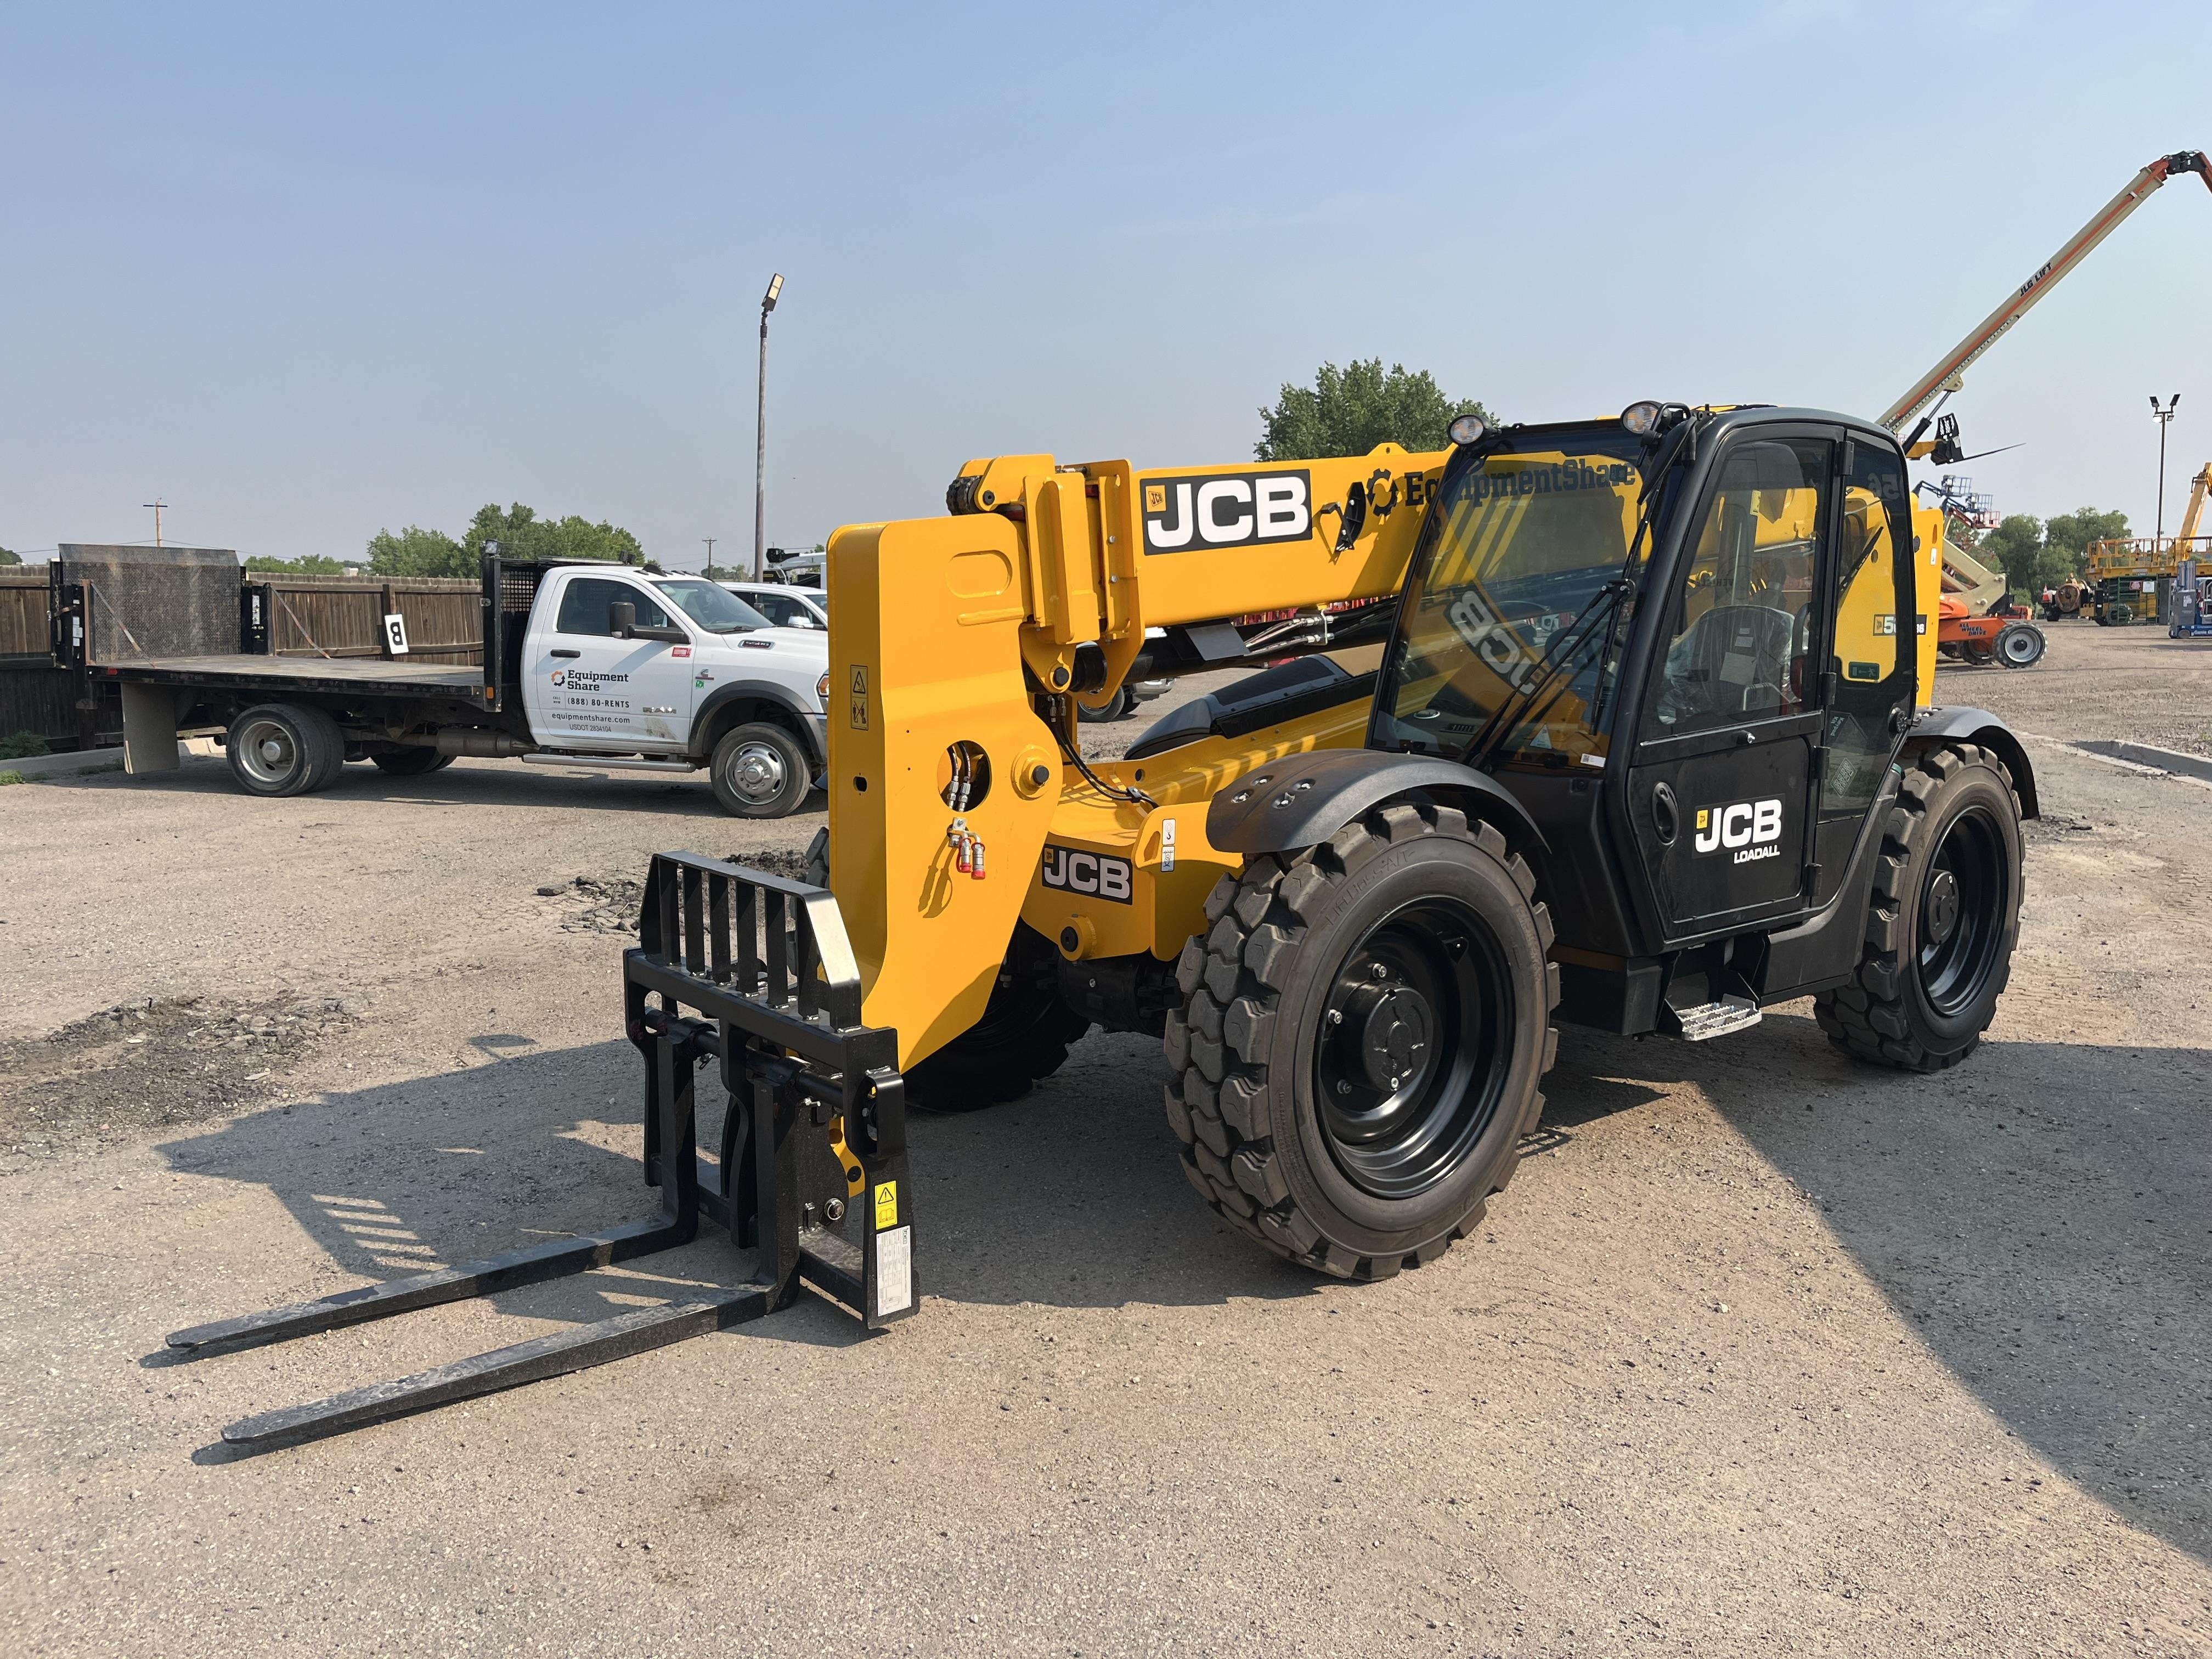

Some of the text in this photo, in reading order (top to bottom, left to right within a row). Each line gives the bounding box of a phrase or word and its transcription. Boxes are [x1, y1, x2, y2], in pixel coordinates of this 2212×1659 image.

[2020, 262, 2051, 296] JLG LIFT
[1147, 476, 1309, 548] JCB
[567, 670, 629, 682] Equipment
[567, 680, 600, 691] Share
[567, 697, 629, 708] (888) 80-RENTS
[552, 713, 630, 724] equipmentshare.com
[1695, 799, 1781, 853] JCB
[1734, 845, 1780, 864] LOADALL
[1044, 850, 1130, 899] JCB
